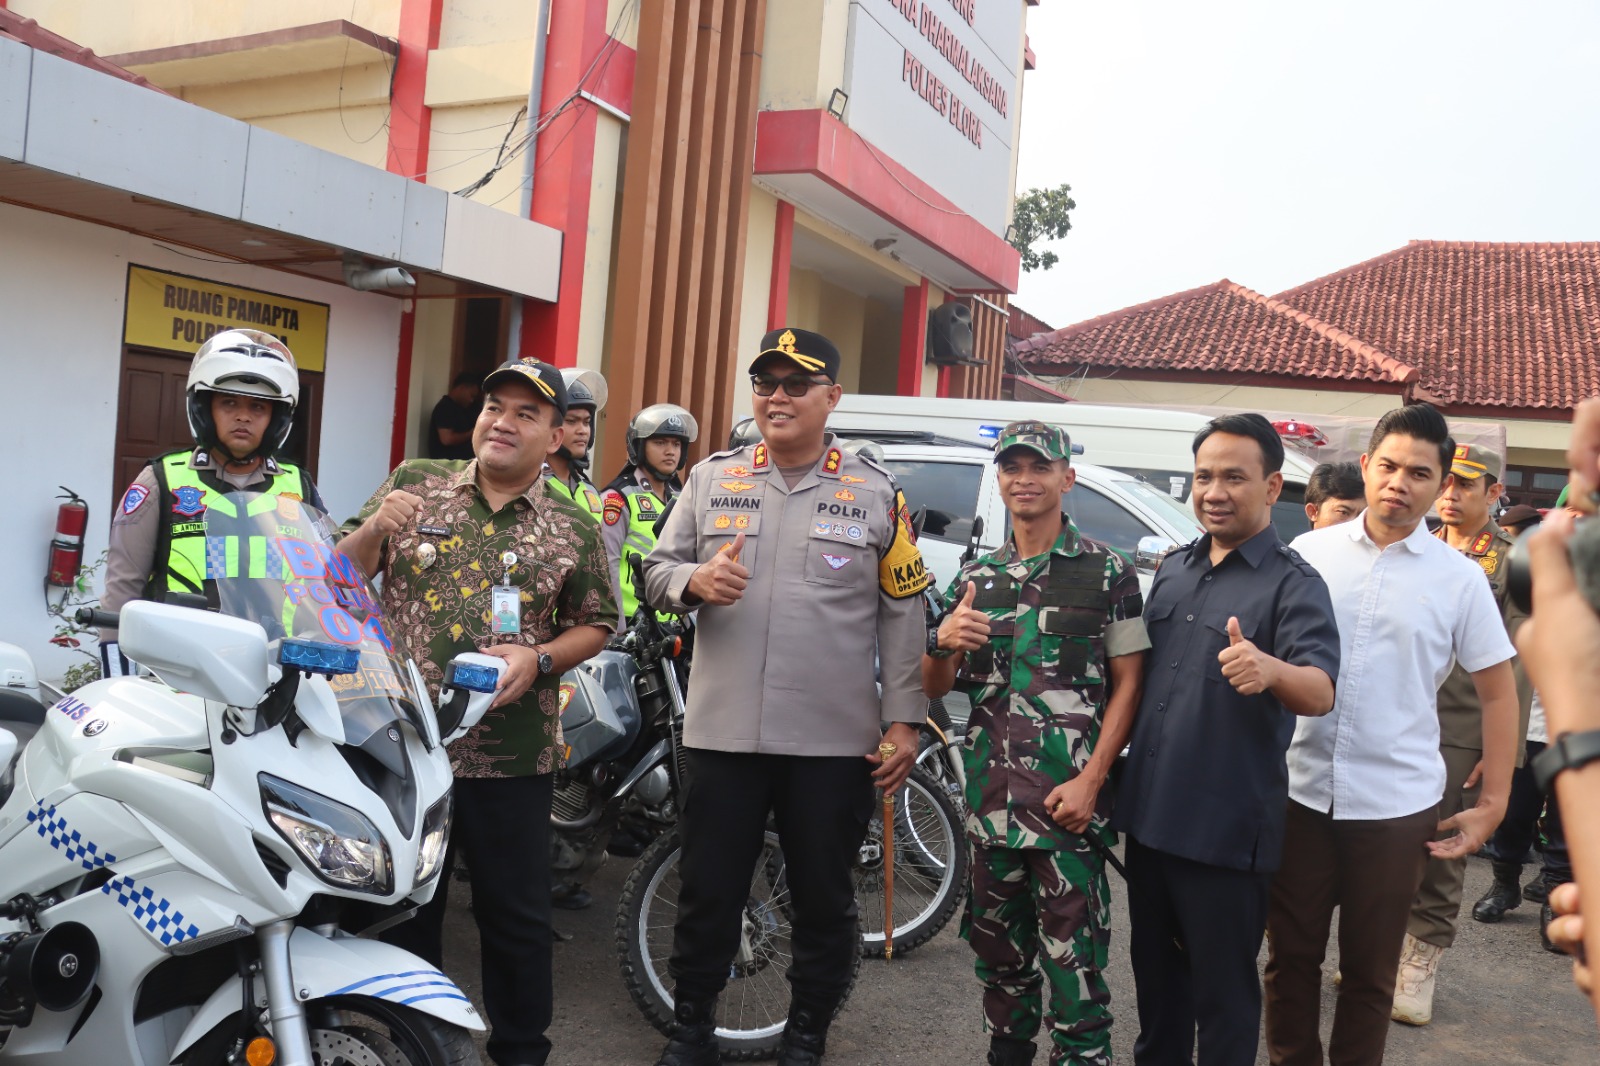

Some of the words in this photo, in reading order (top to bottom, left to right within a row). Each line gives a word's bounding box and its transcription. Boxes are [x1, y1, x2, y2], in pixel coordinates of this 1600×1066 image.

[919, 2, 1008, 119] DHARMALAKSANA
[902, 49, 949, 117] POLRES
[949, 93, 982, 149] BLORA
[164, 284, 223, 318] RUANG
[227, 296, 299, 331] PAMAPTA
[171, 317, 235, 344] POLR
[710, 497, 761, 509] WAWAN
[817, 502, 867, 520] POLRI
